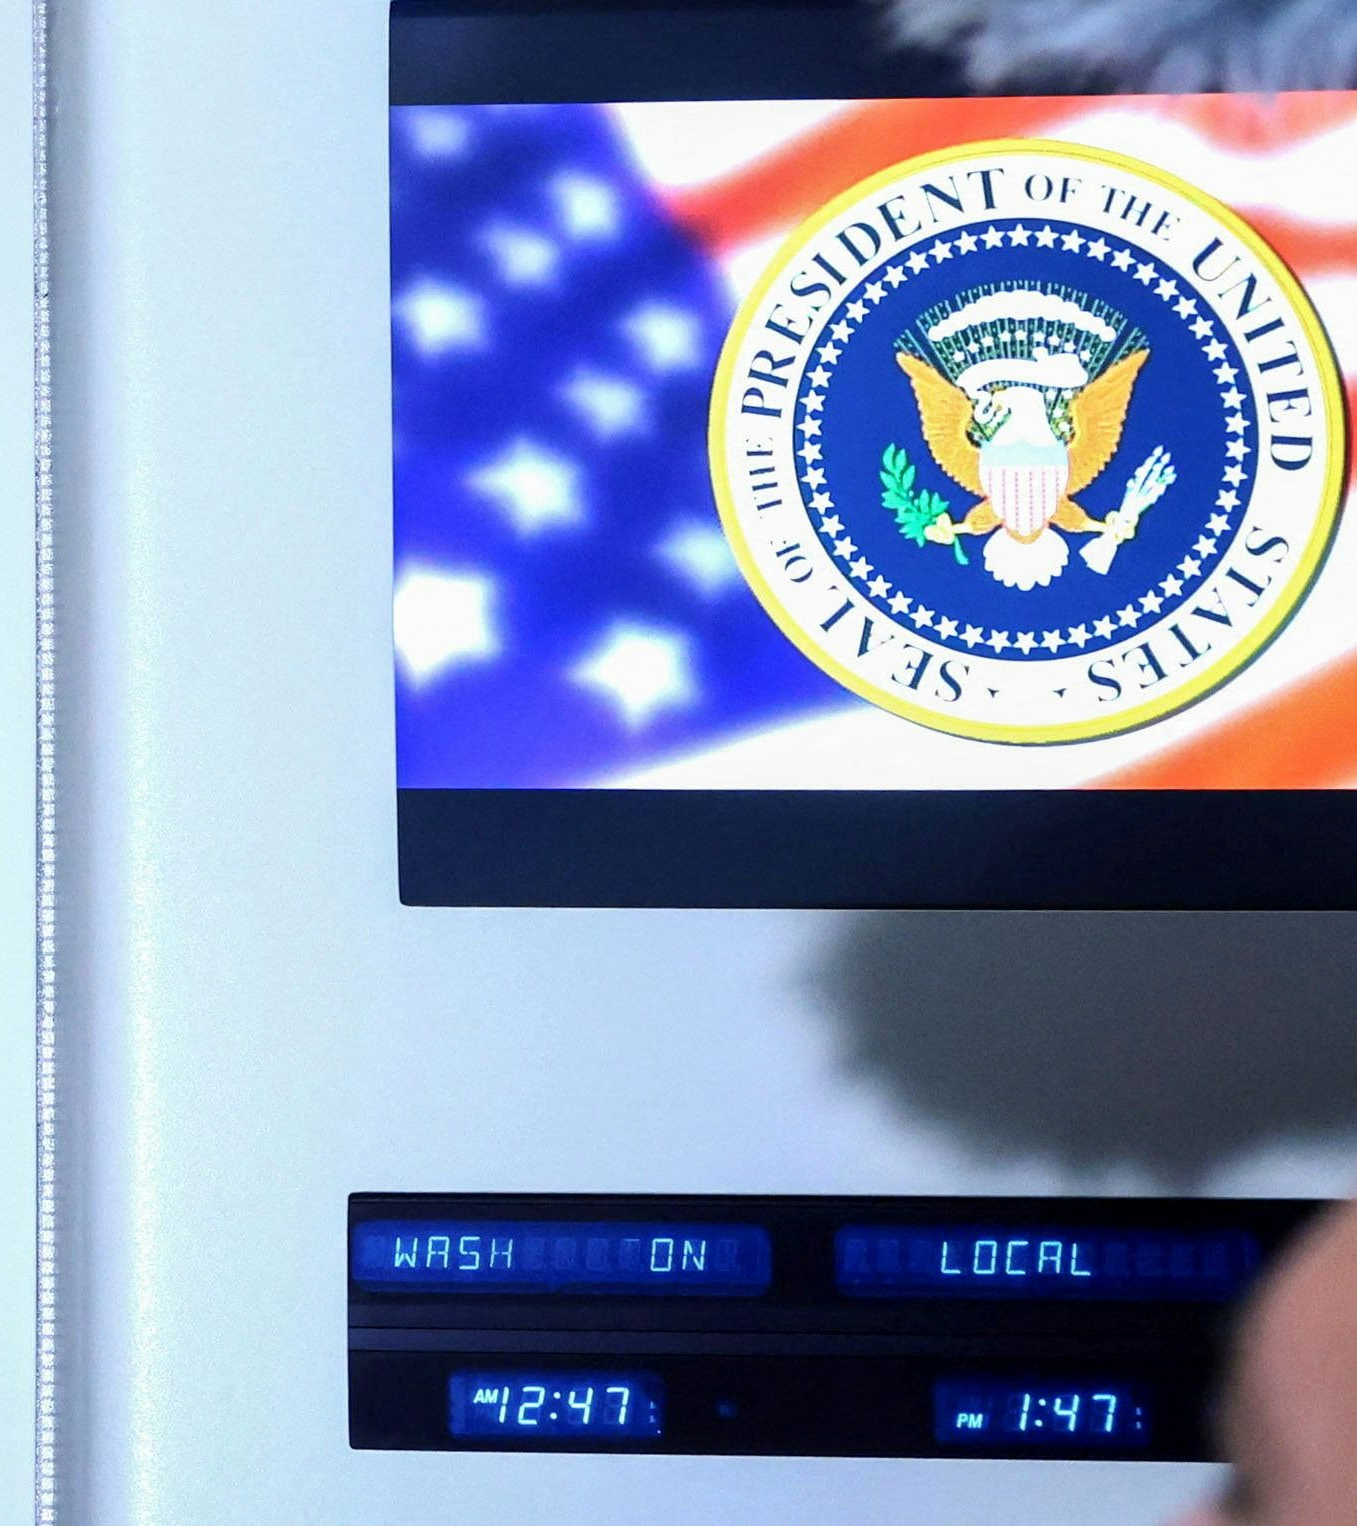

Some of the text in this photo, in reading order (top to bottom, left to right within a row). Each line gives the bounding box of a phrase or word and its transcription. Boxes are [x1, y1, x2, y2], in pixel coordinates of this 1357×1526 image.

[1024, 173, 1083, 203] OF
[1100, 184, 1181, 242] THE
[740, 168, 1005, 419] PRESIDENT
[1191, 238, 1314, 472] UNITED
[771, 538, 813, 584] OF
[1086, 526, 1290, 703] STATES
[819, 584, 971, 703] SEAL
[394, 1236, 706, 1273] WASH ON
[940, 1240, 1091, 1276] LOCAL
[473, 1386, 630, 1425] AM 12:47
[956, 1393, 1116, 1432] PM 1:47
